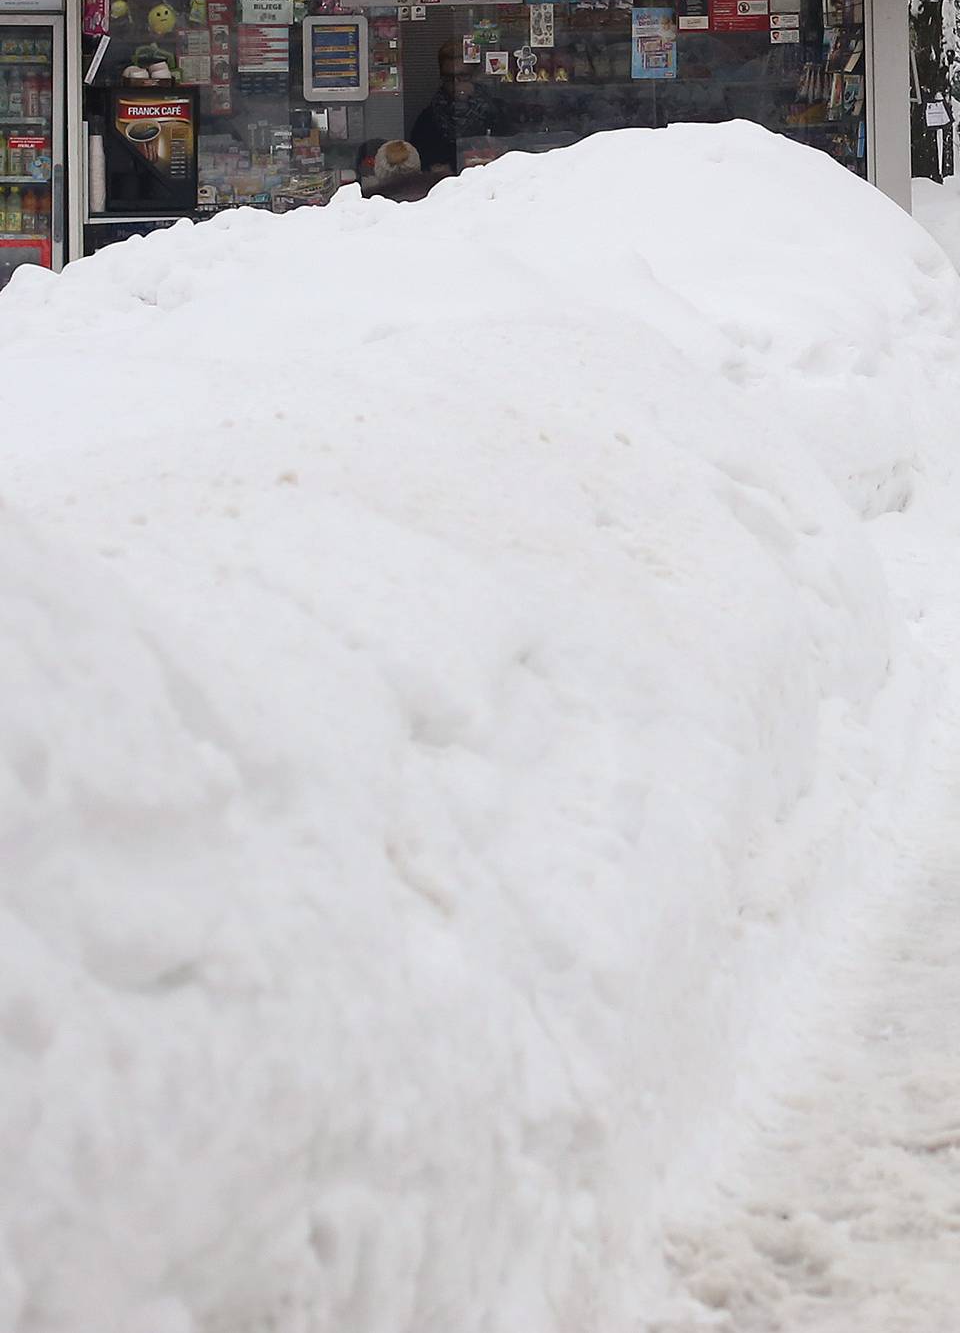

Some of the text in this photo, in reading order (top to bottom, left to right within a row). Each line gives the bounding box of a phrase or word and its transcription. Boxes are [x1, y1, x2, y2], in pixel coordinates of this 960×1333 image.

[253, 3, 282, 11] BILJEGE
[128, 105, 182, 116] FRANCK CAFÉ
